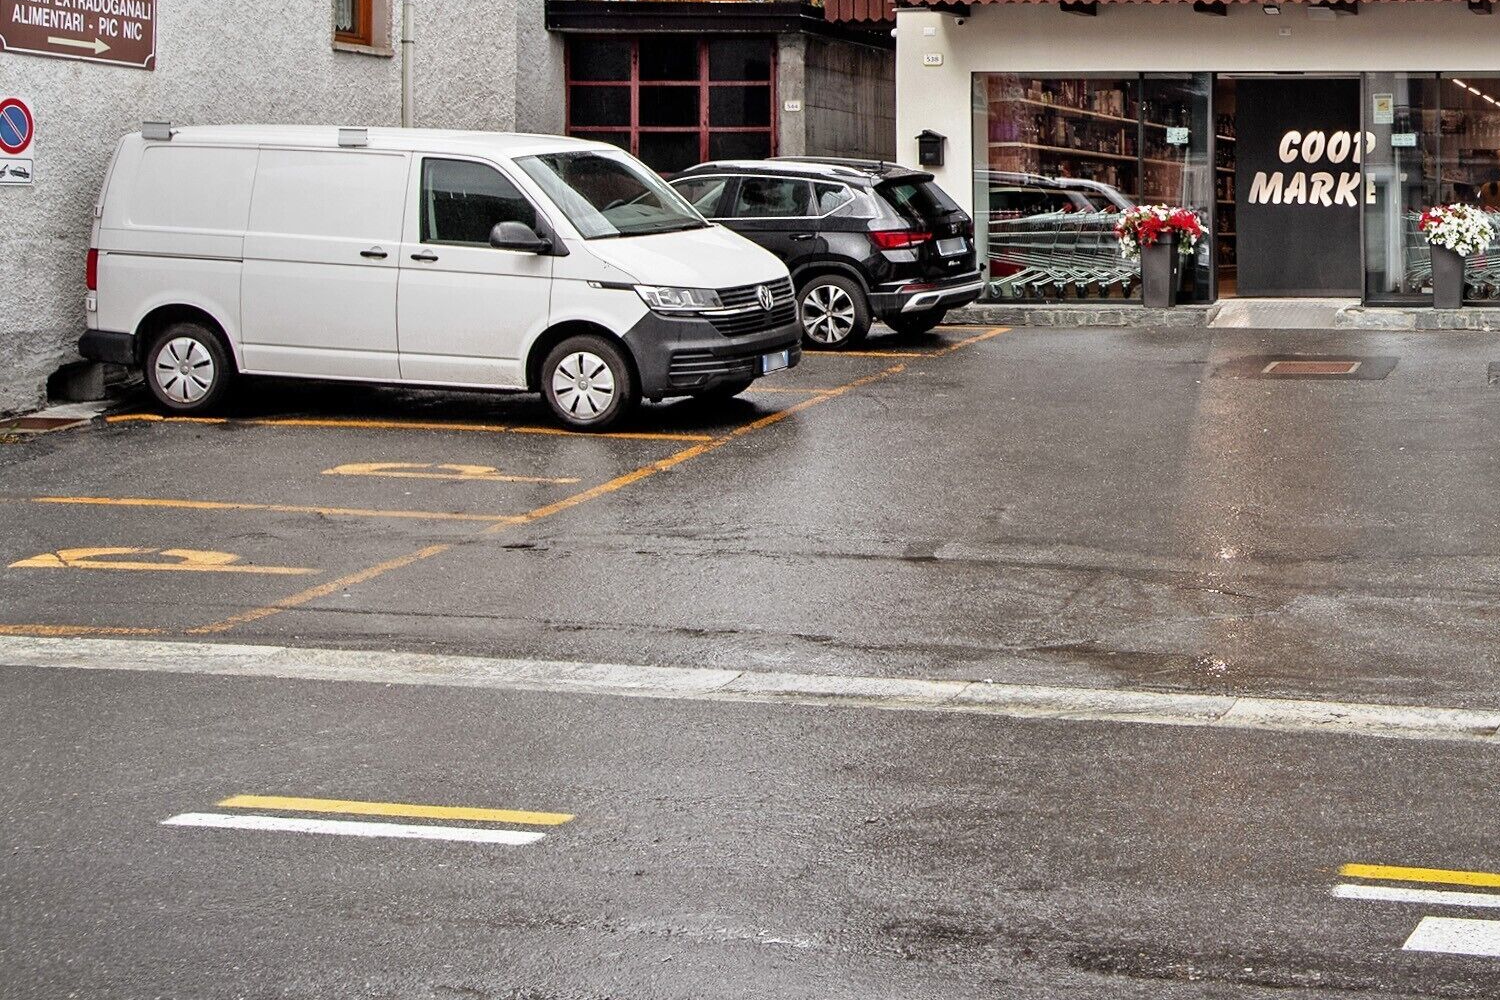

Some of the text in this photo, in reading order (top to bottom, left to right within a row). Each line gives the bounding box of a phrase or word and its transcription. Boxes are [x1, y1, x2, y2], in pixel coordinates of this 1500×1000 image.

[12, 4, 84, 32] ALIMENTARI
[99, 17, 118, 37] PIC
[123, 21, 143, 41] NIC
[1279, 130, 1376, 164] COOP
[1248, 171, 1407, 207] MARKE
